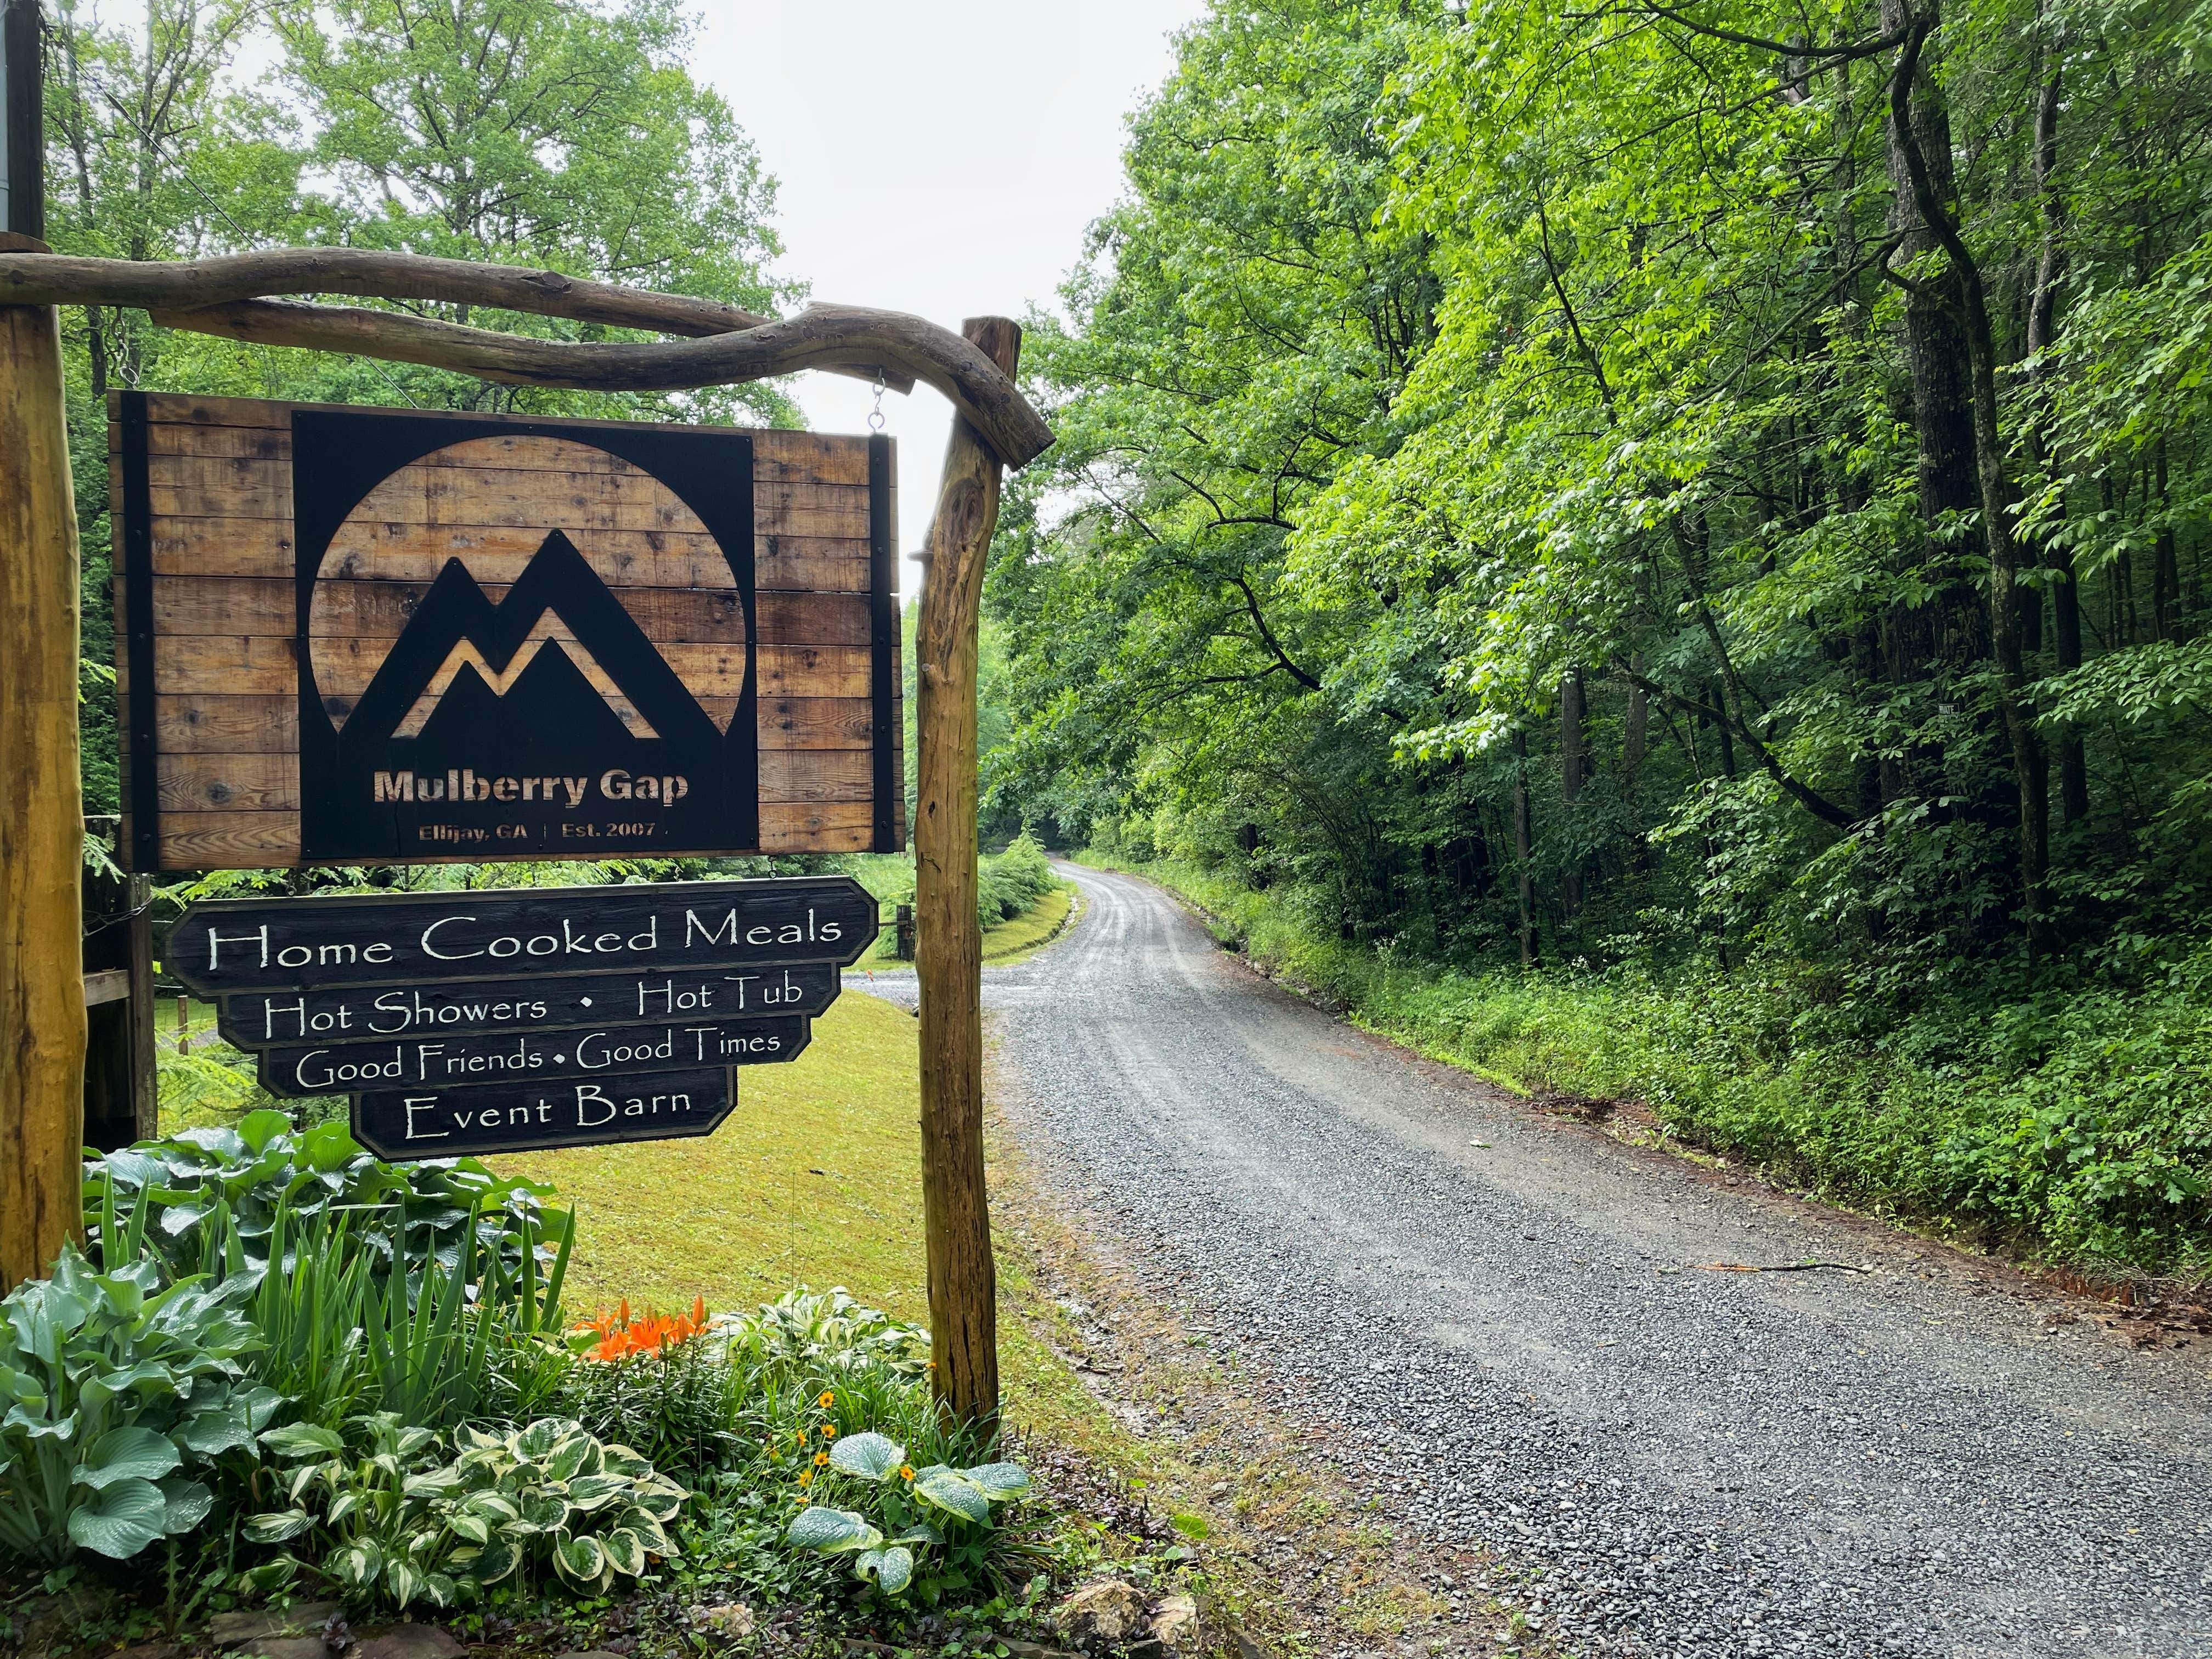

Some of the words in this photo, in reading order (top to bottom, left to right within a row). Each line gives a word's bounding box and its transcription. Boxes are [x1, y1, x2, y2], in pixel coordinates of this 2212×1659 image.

[374, 769, 588, 808] Mulberry
[600, 769, 688, 807] Gap
[419, 824, 490, 843] Ellijay,
[495, 823, 528, 839] GA
[561, 822, 601, 838] Est.
[606, 822, 656, 837] 2007
[208, 925, 393, 970] Home
[421, 915, 657, 960] Cooked
[684, 908, 842, 948] Meals
[264, 998, 352, 1039] Hot
[368, 991, 547, 1033] Showers
[637, 979, 712, 1015] Hot
[724, 969, 803, 1009] Tub
[296, 1046, 402, 1087] Good
[417, 1038, 543, 1080] Friends
[576, 1029, 672, 1069] Good
[684, 1027, 780, 1061] Times
[403, 1096, 552, 1139] Event
[574, 1085, 690, 1126] Barn
